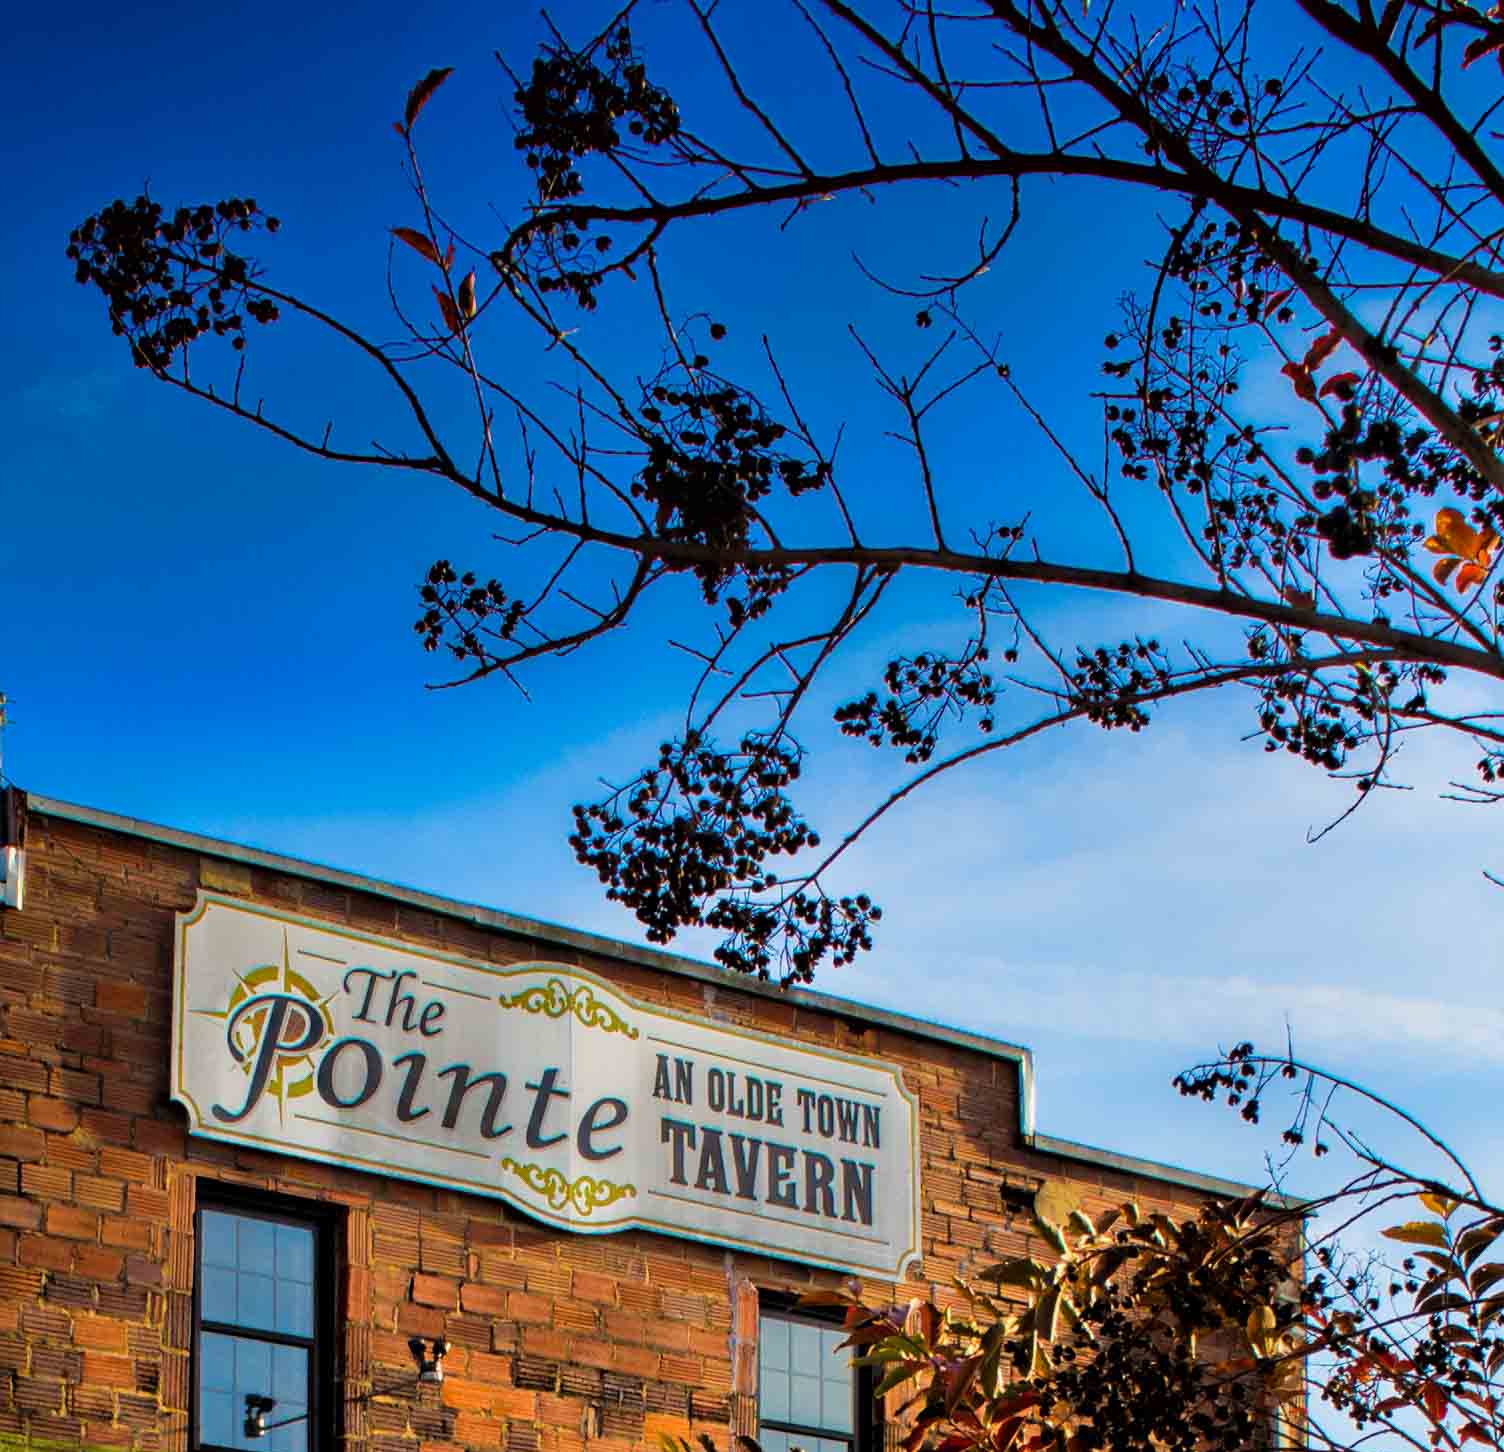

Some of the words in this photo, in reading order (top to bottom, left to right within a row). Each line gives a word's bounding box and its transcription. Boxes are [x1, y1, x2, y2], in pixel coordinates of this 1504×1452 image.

[343, 966, 446, 1038] The
[211, 993, 630, 1162] Pointe
[651, 1052, 694, 1107] AN
[706, 1066, 784, 1128] OLDE
[796, 1086, 882, 1151] TOWN
[660, 1119, 876, 1229] TAVERN
